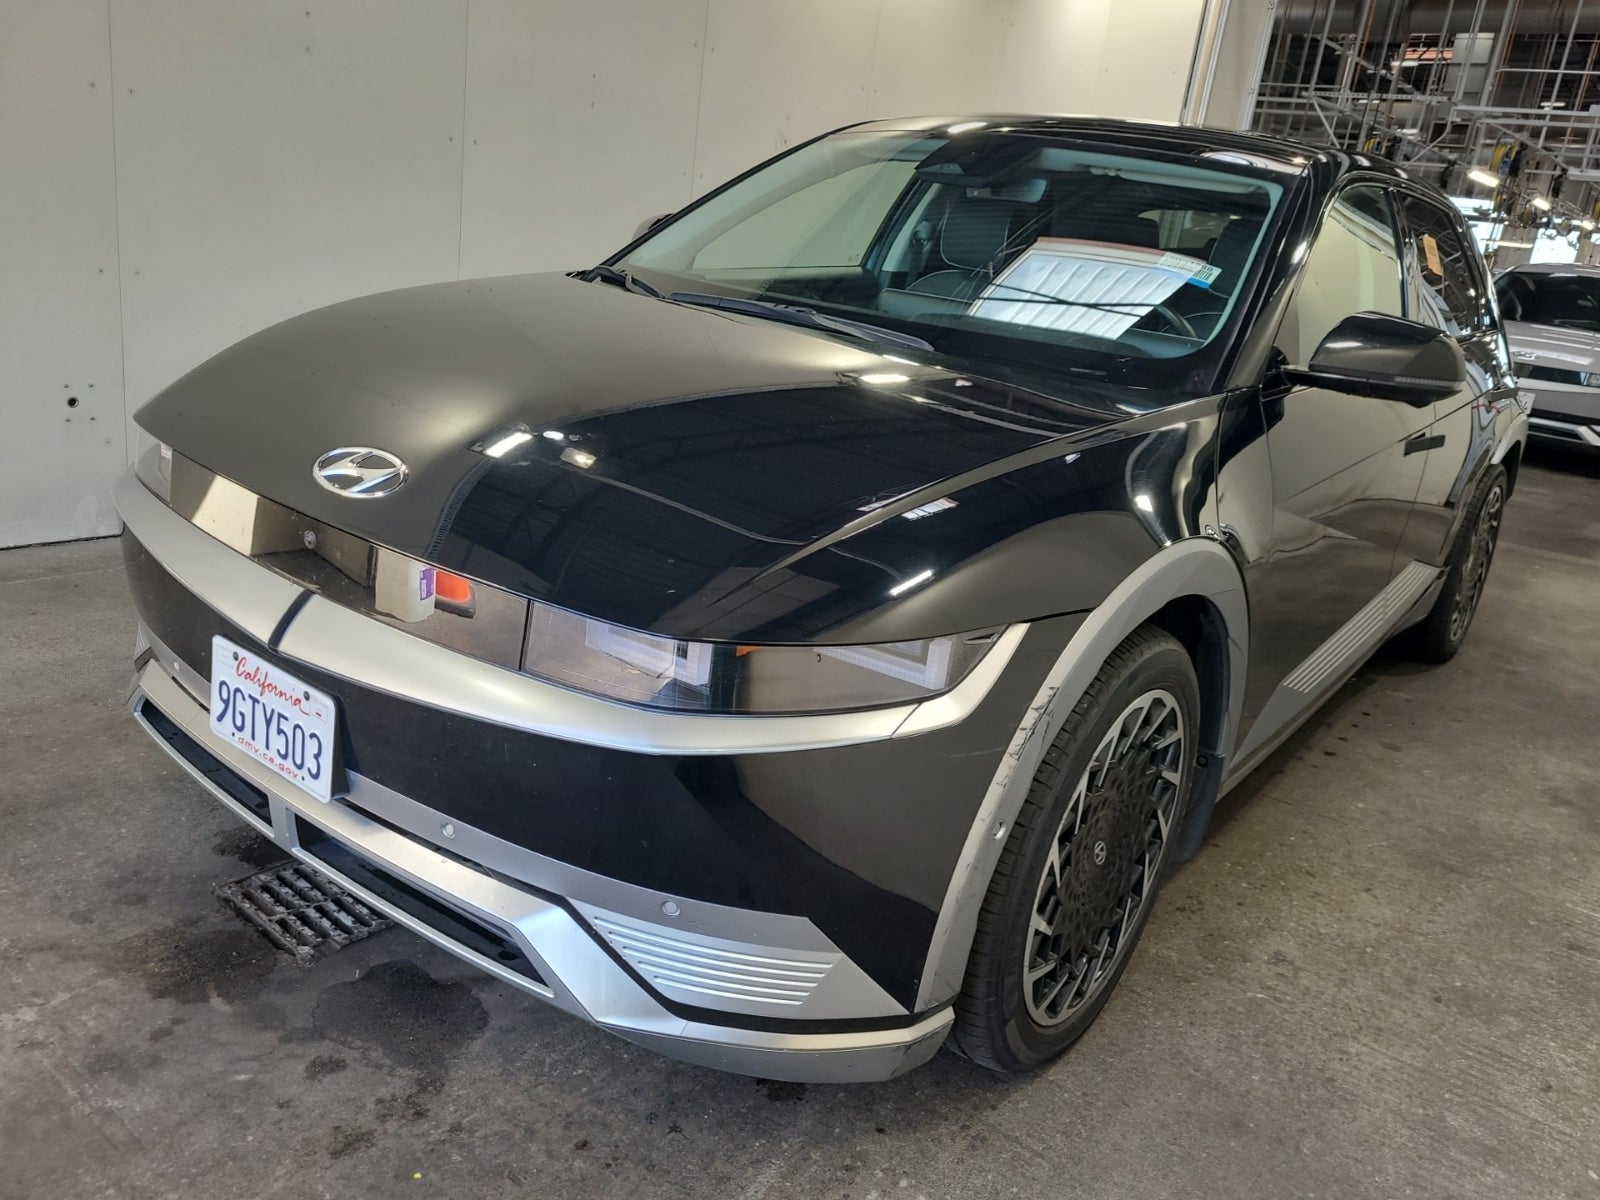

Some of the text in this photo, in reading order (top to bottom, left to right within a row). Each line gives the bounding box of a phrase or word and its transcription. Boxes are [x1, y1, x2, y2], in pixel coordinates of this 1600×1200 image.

[236, 657, 310, 716] California
[216, 680, 322, 780] 9GTY503
[237, 737, 299, 779] dmv.ca.gov
